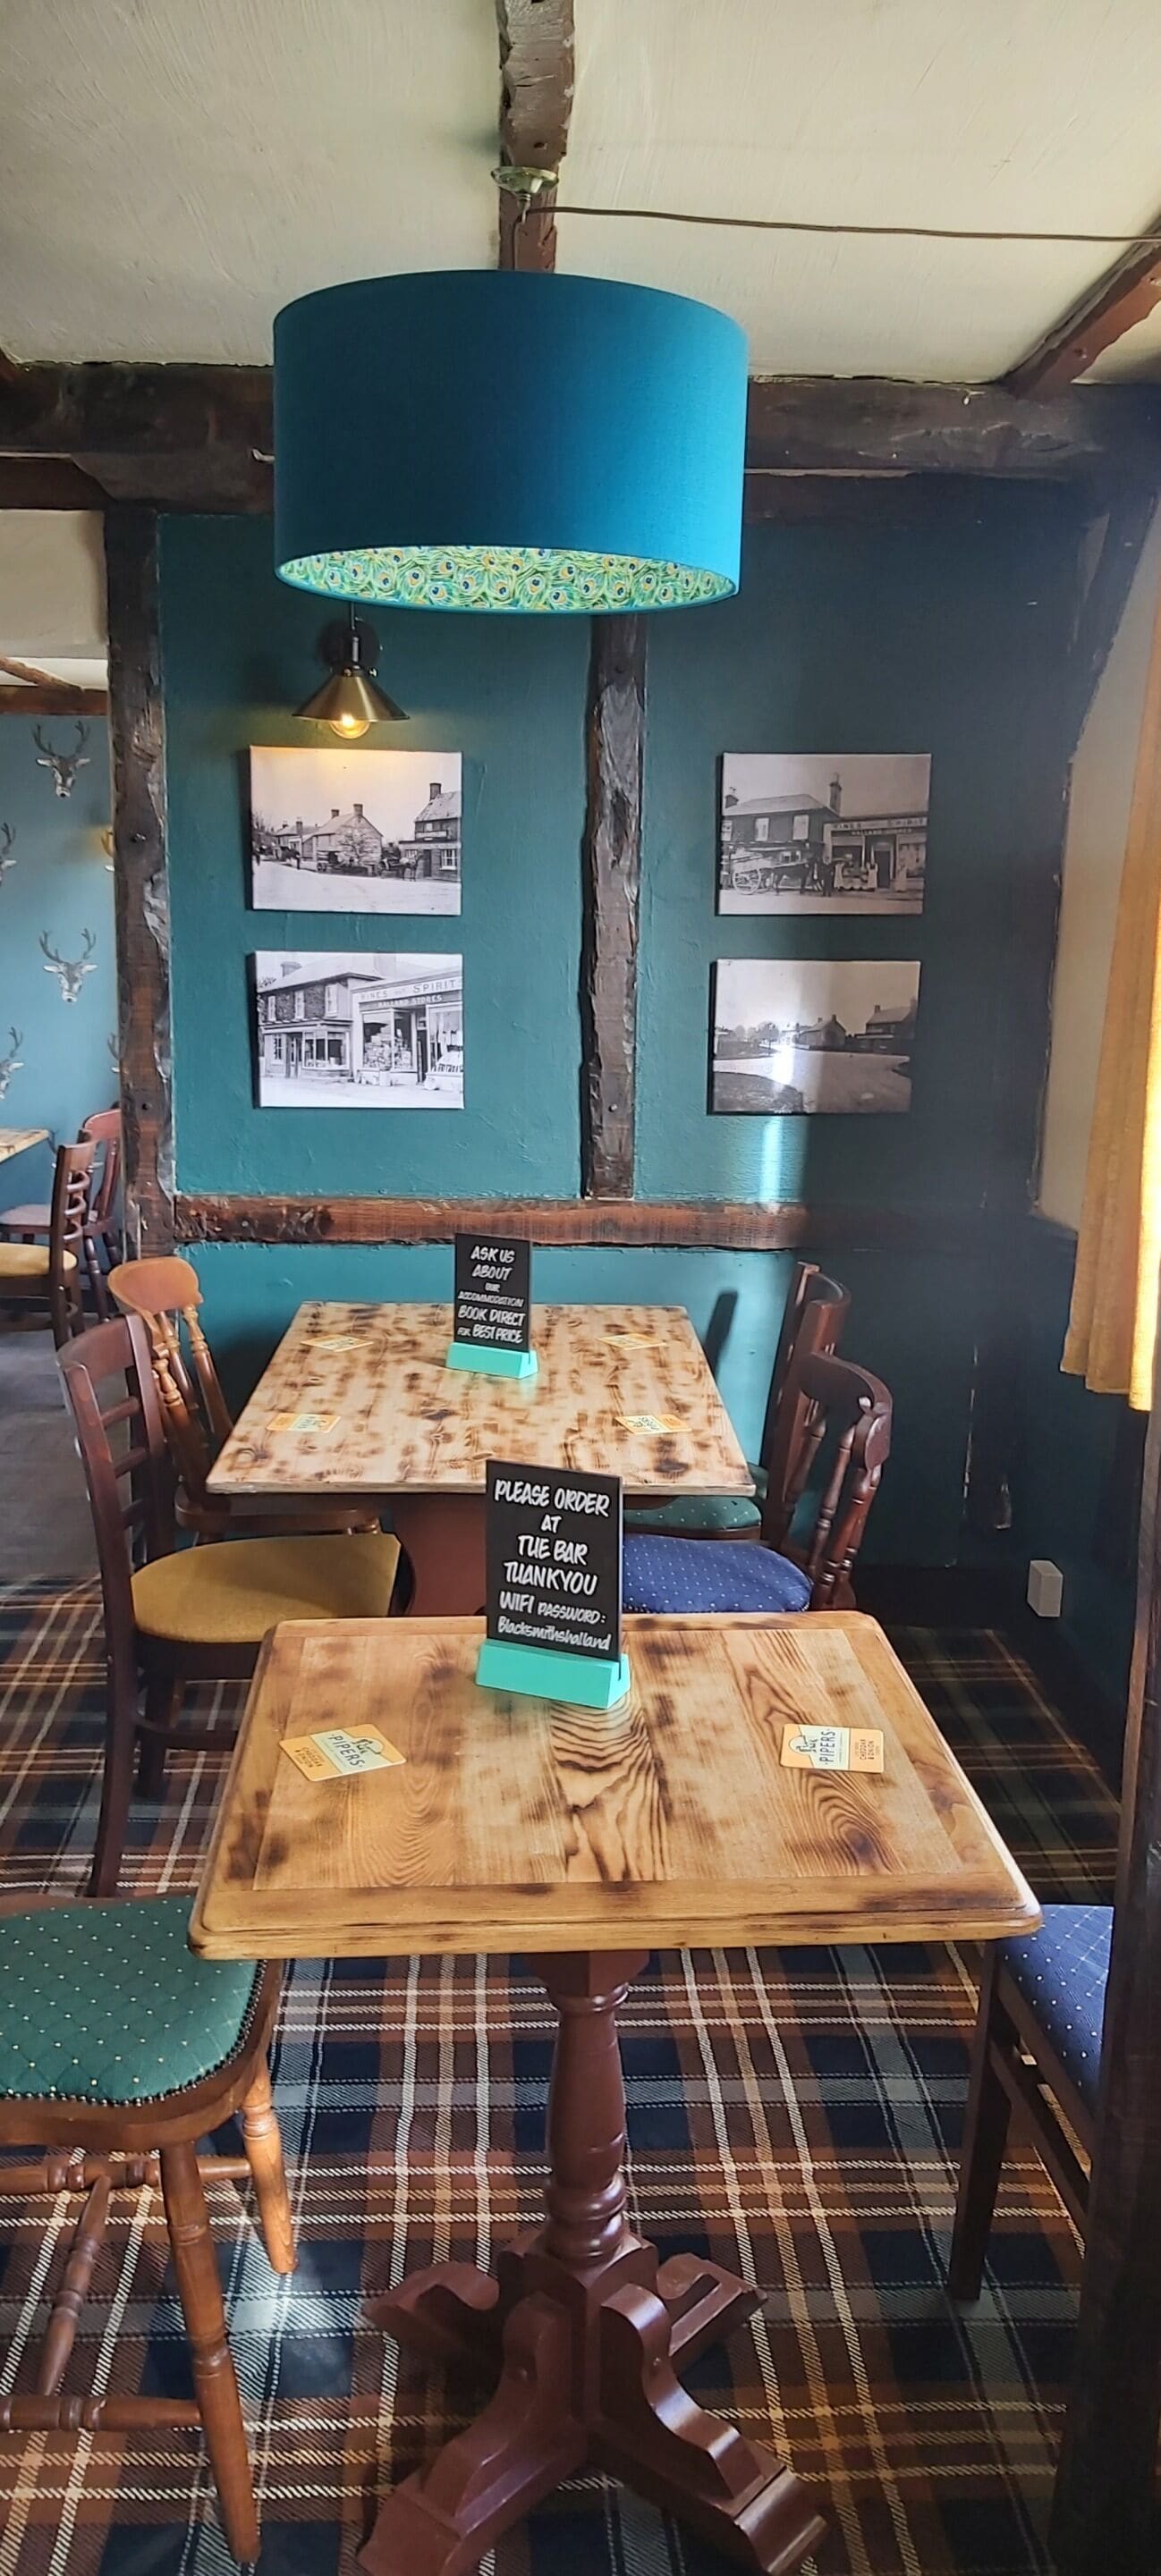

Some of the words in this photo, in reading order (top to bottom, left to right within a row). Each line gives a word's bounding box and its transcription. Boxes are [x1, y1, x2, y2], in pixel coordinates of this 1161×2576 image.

[412, 979, 455, 993] SPIRIT
[470, 1246, 496, 1263] ASK
[499, 1249, 515, 1263] US
[472, 1263, 513, 1281] ABOUT
[485, 1282, 501, 1293] OUR
[457, 1291, 524, 1307] ACCOMMODATION
[458, 1305, 487, 1322] BOOK
[489, 1309, 527, 1326] DIRECT
[457, 1327, 471, 1337] FOR
[472, 1323, 496, 1340] BEST
[495, 1326, 524, 1344] PRICE
[494, 1479, 550, 1508] PLEASE
[555, 1488, 610, 1517] ORDER
[540, 1514, 562, 1533] AT
[553, 1541, 588, 1565] BAR
[499, 1591, 535, 1613] WIFI
[538, 1601, 606, 1625] PASSWORD:
[328, 1735, 365, 1767] PIPERS
[819, 1731, 836, 1762] PIPERS
